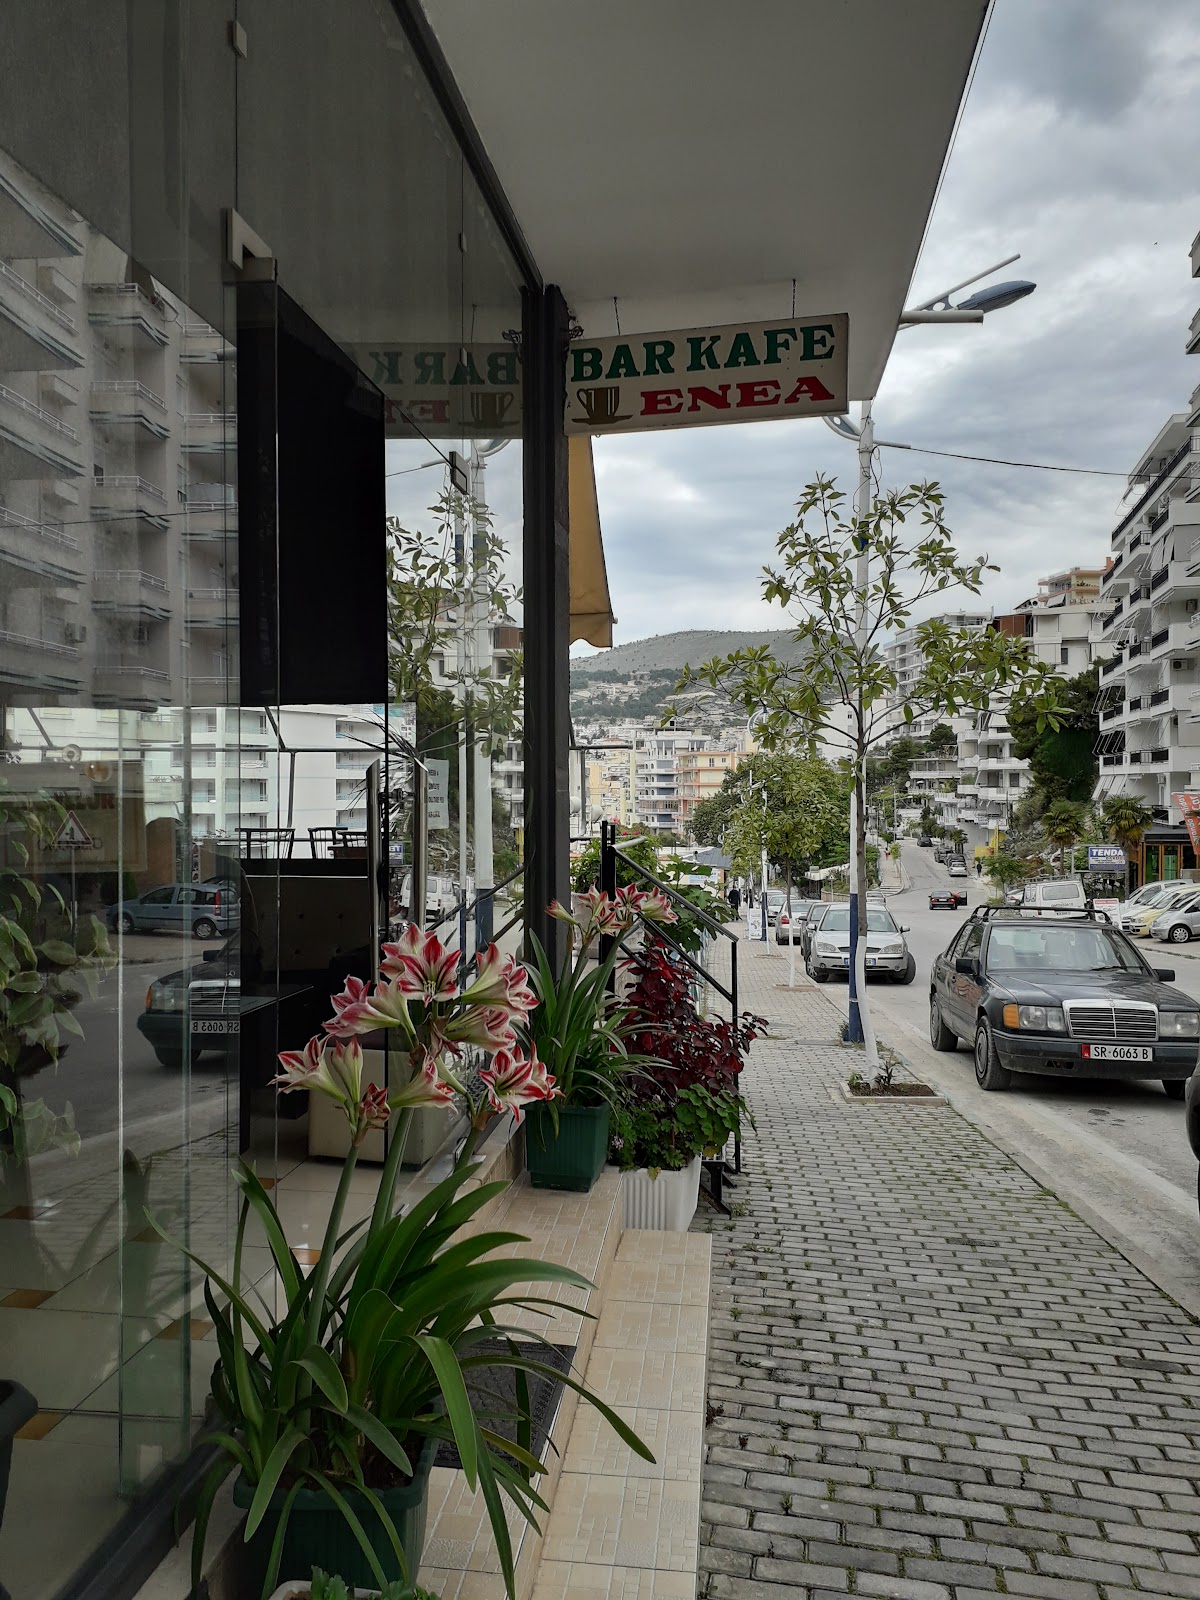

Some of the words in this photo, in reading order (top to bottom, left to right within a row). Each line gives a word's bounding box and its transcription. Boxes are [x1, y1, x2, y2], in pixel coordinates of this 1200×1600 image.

[570, 339, 675, 382] BAR
[686, 324, 836, 372] KAFE
[640, 376, 835, 416] ENEA
[1094, 1046, 1106, 1058] SR
[1112, 1048, 1138, 1059] 6063
[1142, 1049, 1148, 1060] B
